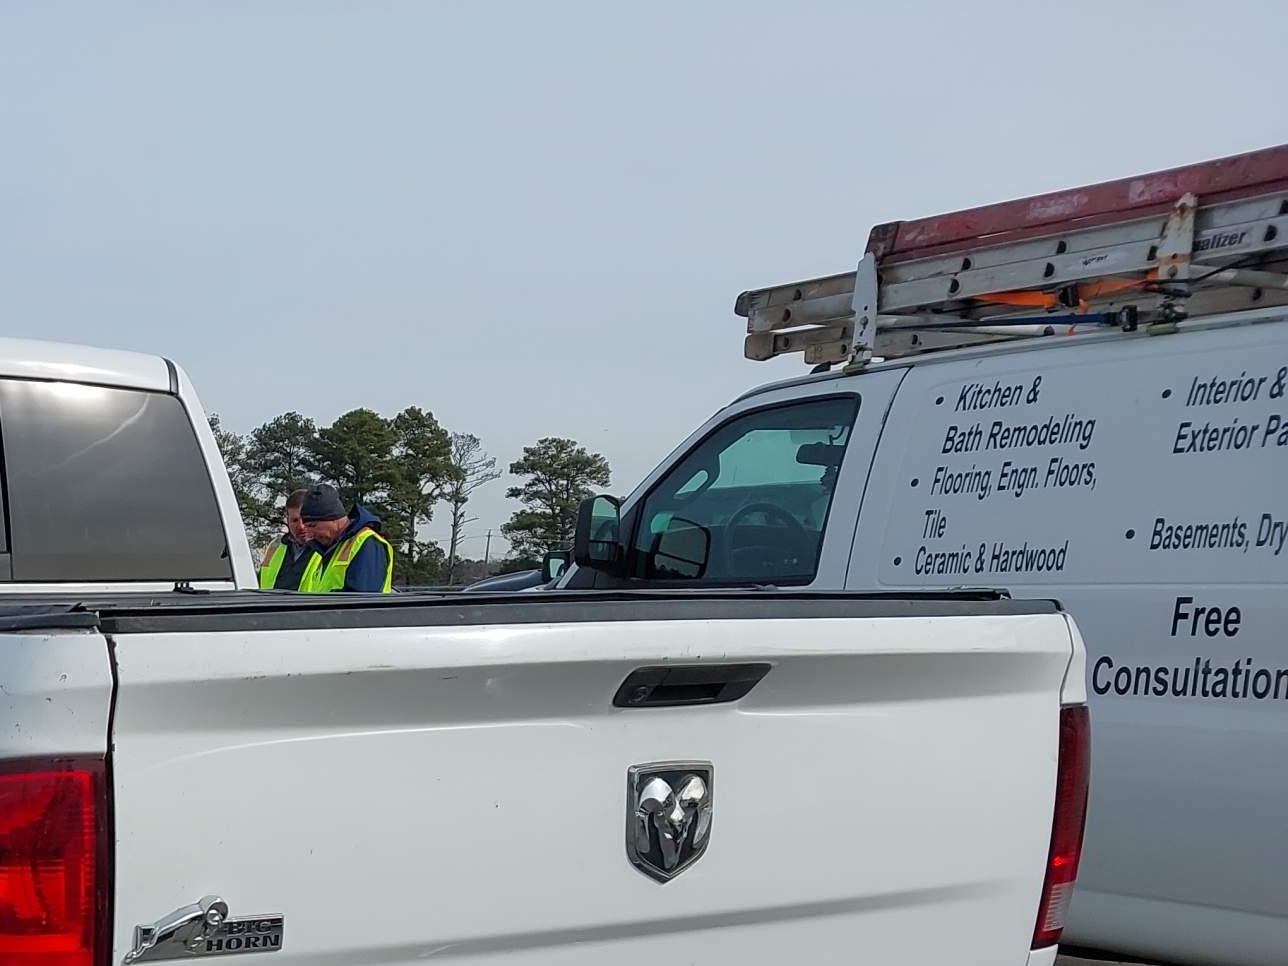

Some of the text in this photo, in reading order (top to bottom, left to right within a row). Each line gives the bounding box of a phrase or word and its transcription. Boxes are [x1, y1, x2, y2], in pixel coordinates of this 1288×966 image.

[955, 376, 1042, 412] Kitchen &
[1186, 366, 1288, 407] Interior &
[942, 414, 1096, 454] Bath Remodeling
[1173, 418, 1260, 454] Exterior
[931, 457, 1096, 500] Flooring, Engn. Floors,
[922, 509, 947, 539] Tile
[1150, 516, 1250, 553] Basements,
[915, 540, 1069, 575] Ceramic & Hardwood
[1171, 596, 1242, 637] Free
[206, 934, 280, 952] HORN
[226, 920, 272, 936] BIG
